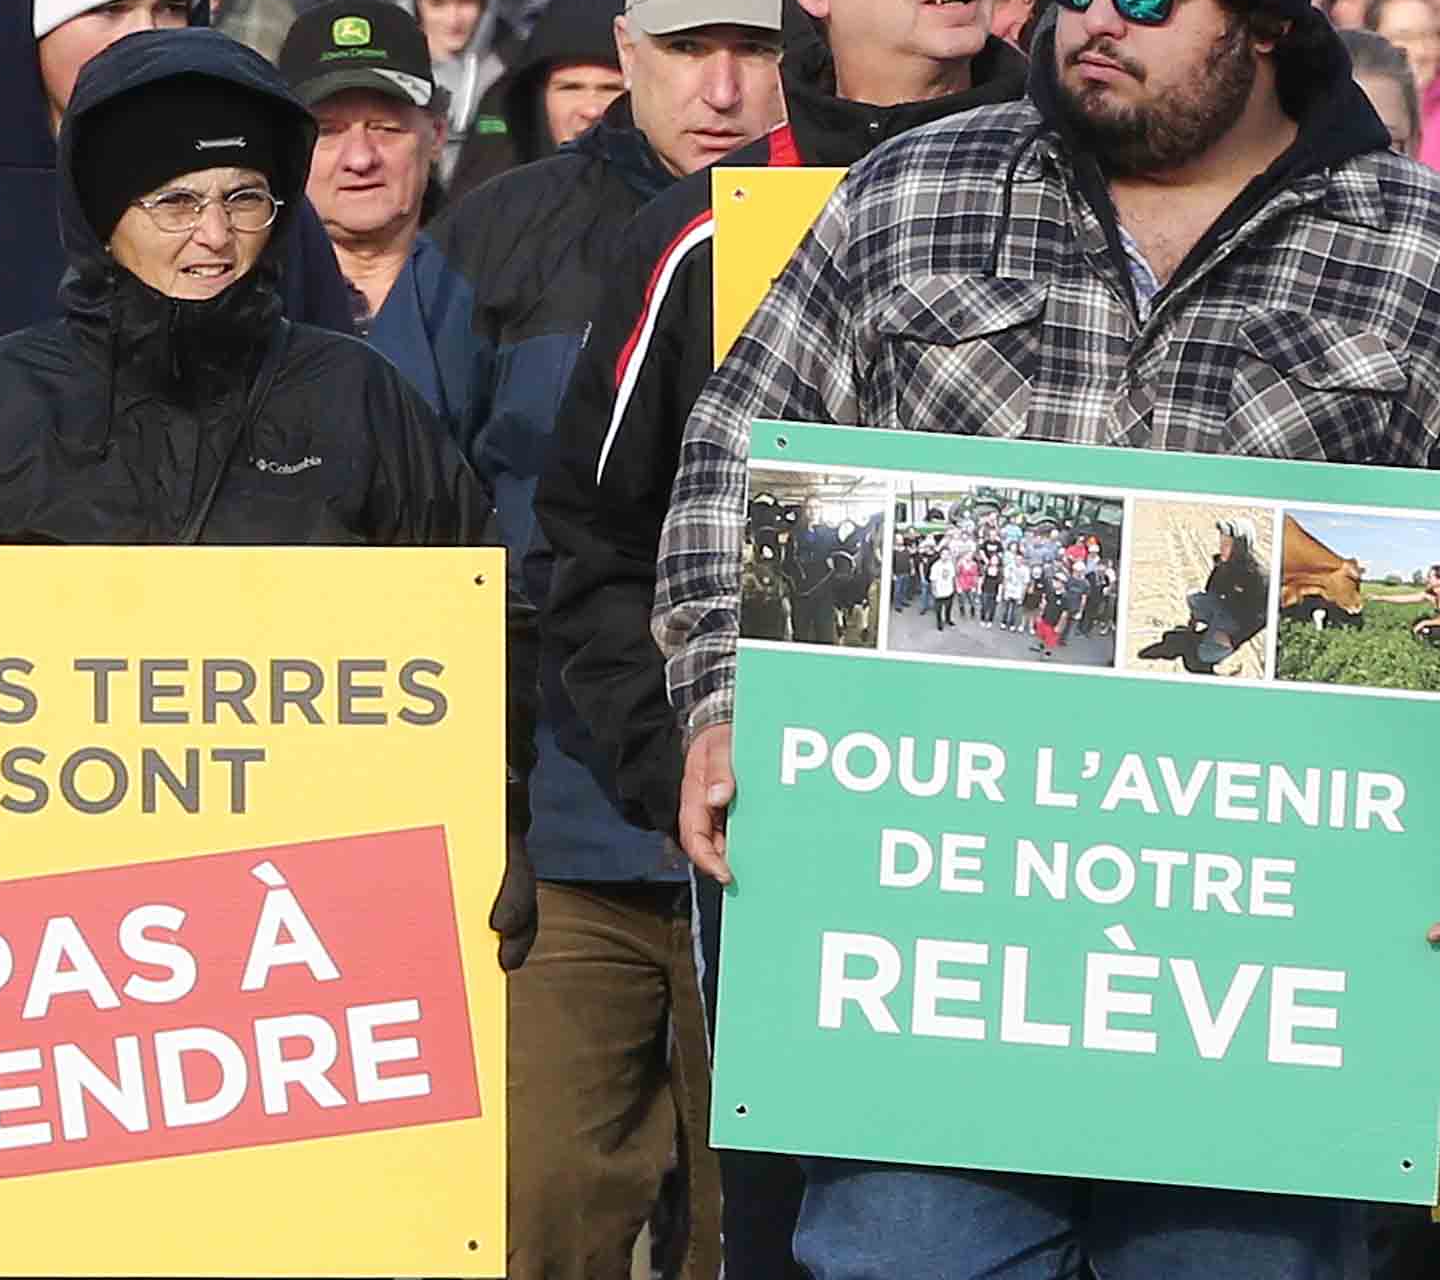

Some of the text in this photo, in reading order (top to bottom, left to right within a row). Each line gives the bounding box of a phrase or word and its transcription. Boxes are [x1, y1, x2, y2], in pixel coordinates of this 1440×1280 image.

[267, 455, 322, 474] Columbia
[73, 658, 449, 726] TERRES
[778, 726, 1409, 834] POUR L'AVENIR
[878, 828, 1297, 919] DE NOTRE
[239, 859, 343, 994] À
[816, 923, 1350, 1070] RELÈVE
